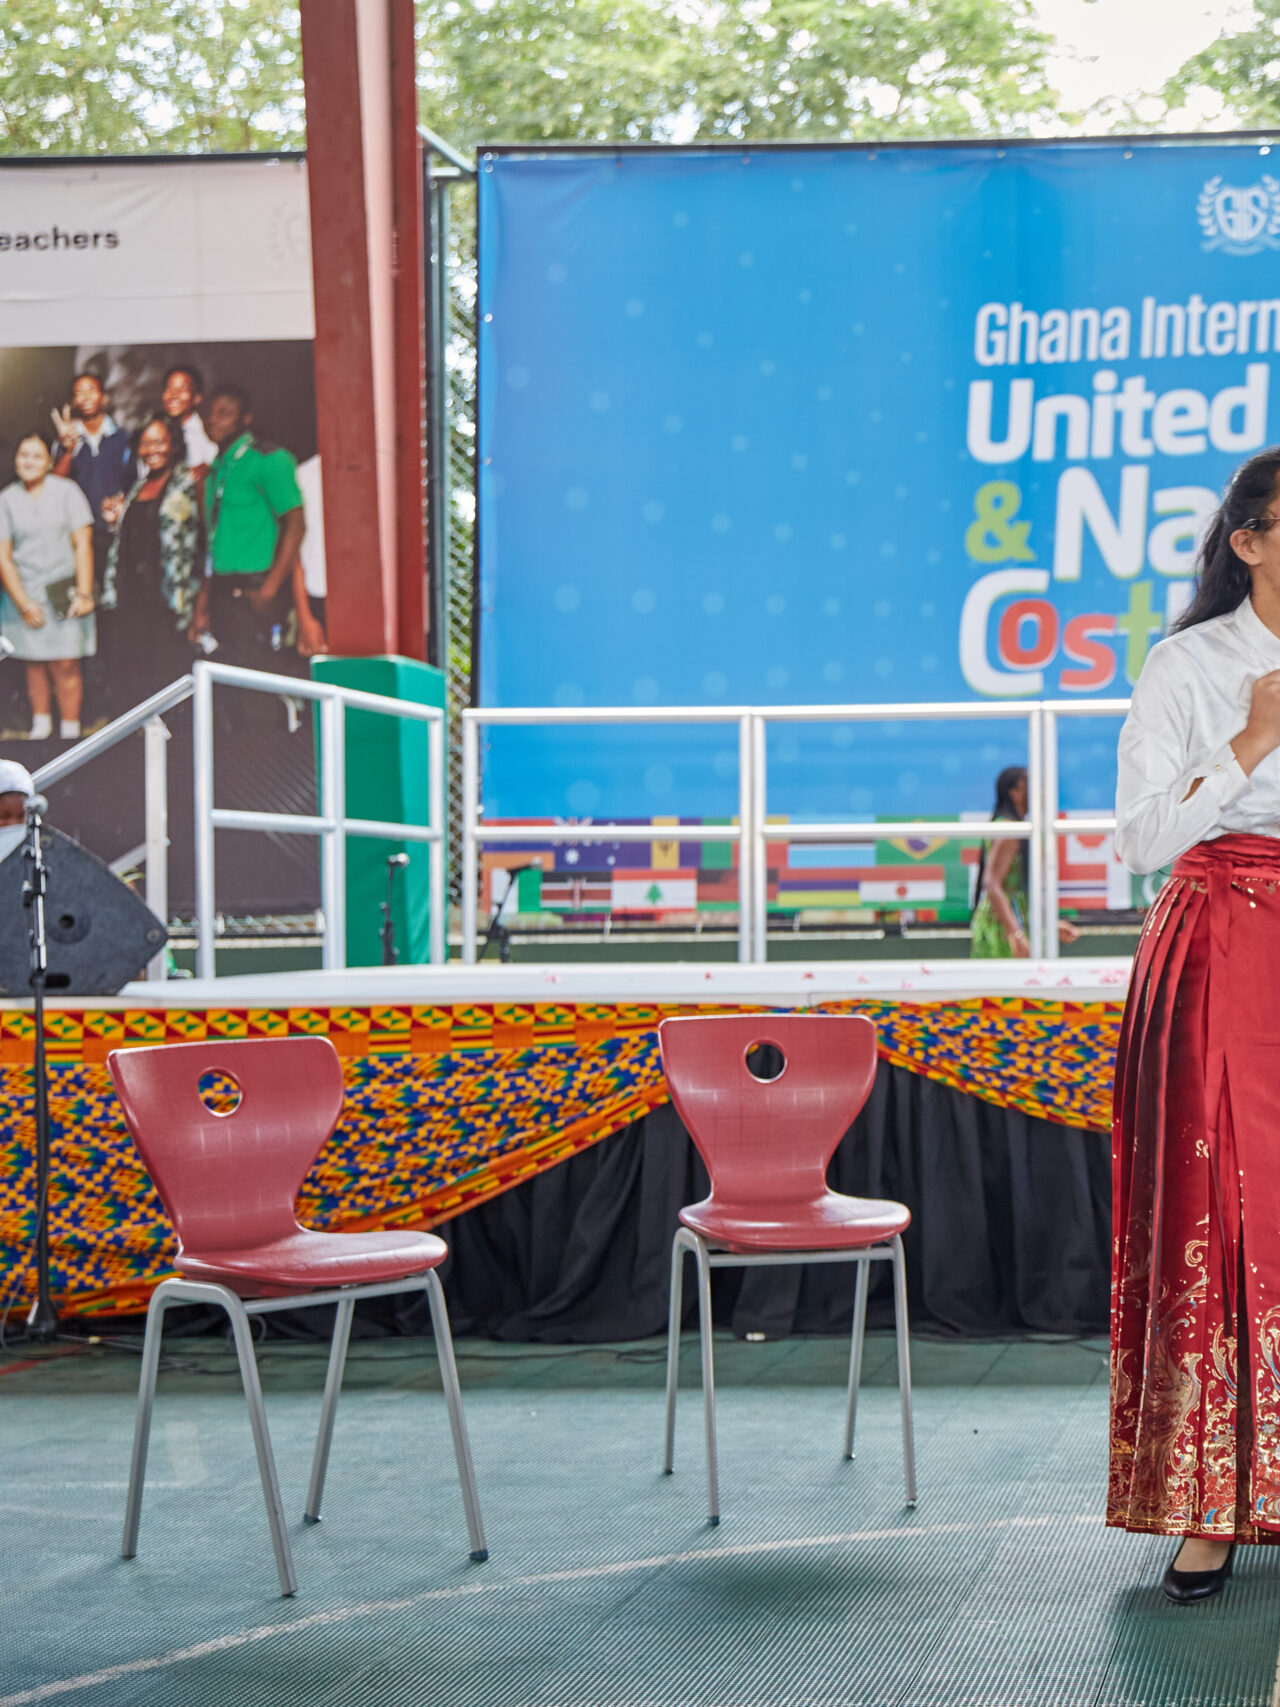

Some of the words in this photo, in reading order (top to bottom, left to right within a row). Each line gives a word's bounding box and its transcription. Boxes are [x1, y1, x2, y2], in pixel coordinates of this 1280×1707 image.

[0, 224, 120, 251] eachers
[973, 300, 1132, 367] Ghana
[966, 361, 1270, 465] United
[964, 479, 1037, 564] &
